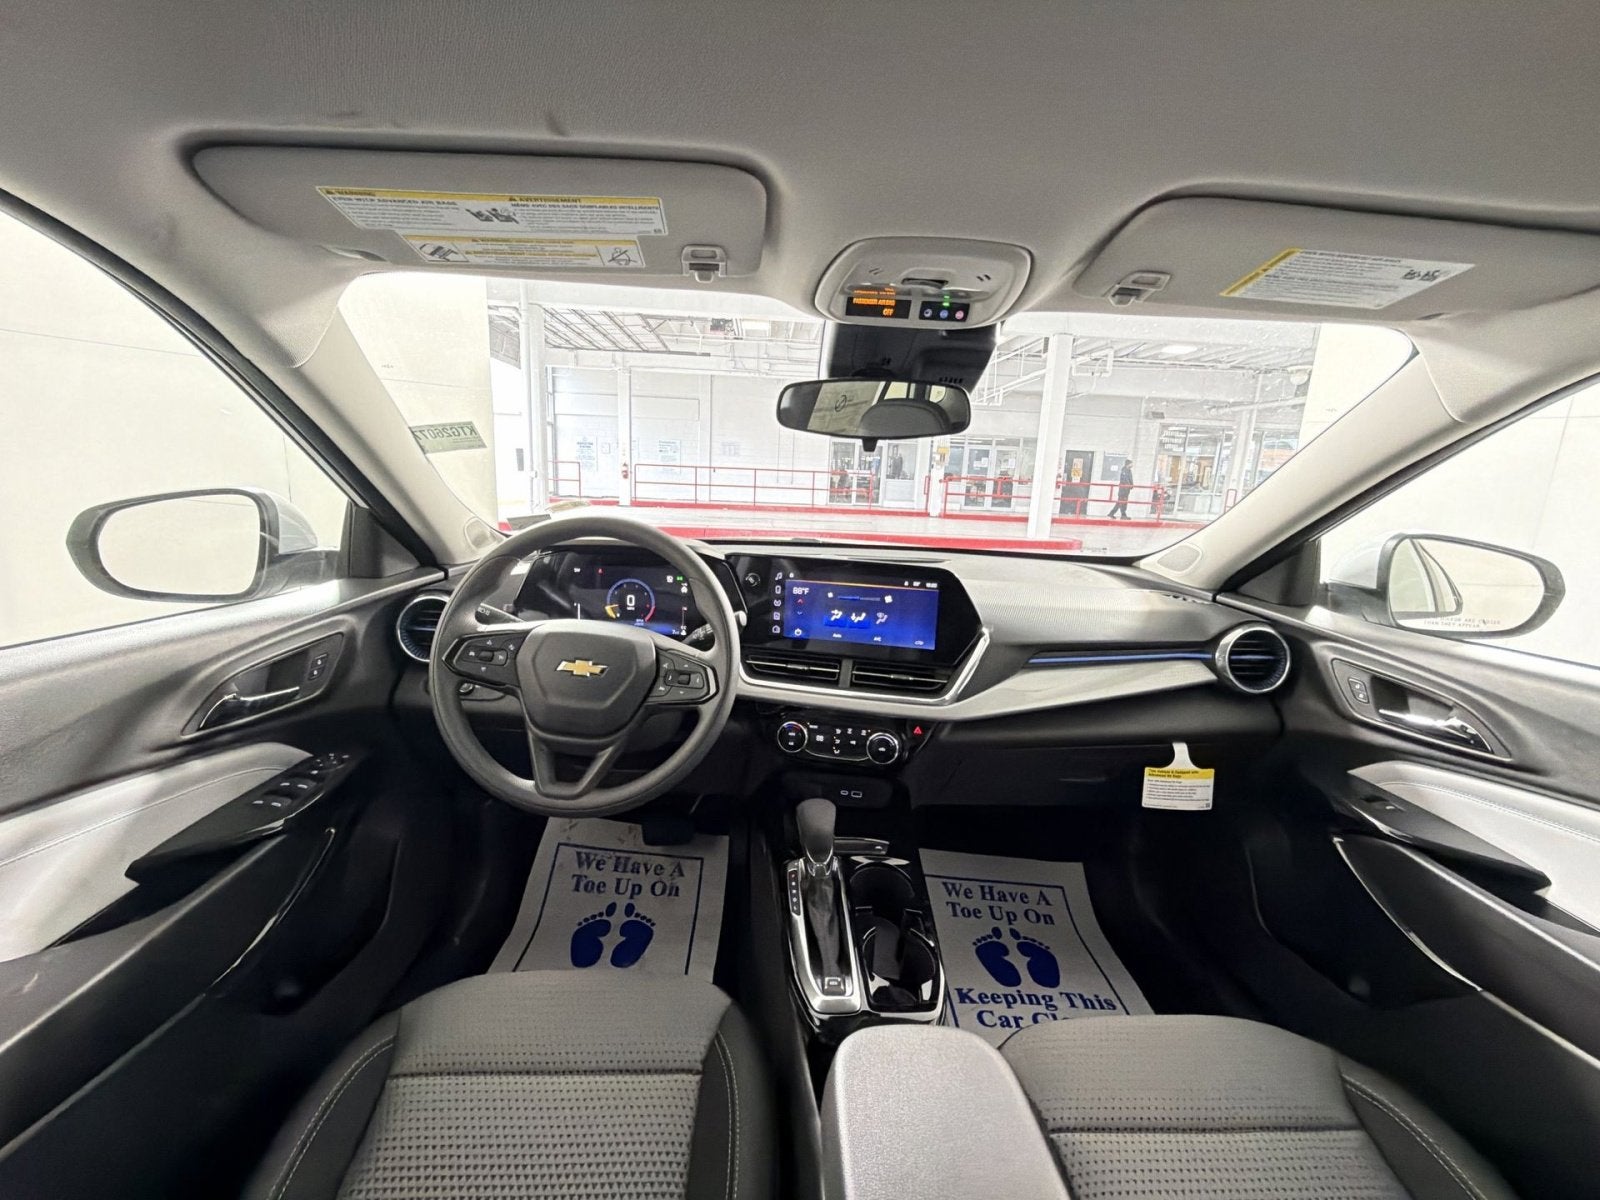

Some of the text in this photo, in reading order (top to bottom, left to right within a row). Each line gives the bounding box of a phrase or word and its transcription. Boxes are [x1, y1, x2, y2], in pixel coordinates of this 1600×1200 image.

[626, 594, 636, 607] 0
[576, 851, 685, 878] We Have A
[571, 874, 681, 899] Toe Up On
[942, 881, 1054, 906] We Have A
[945, 901, 1055, 926] Toe Up On
[954, 987, 1118, 1012] Keeping This
[976, 1010, 1024, 1029] Car
